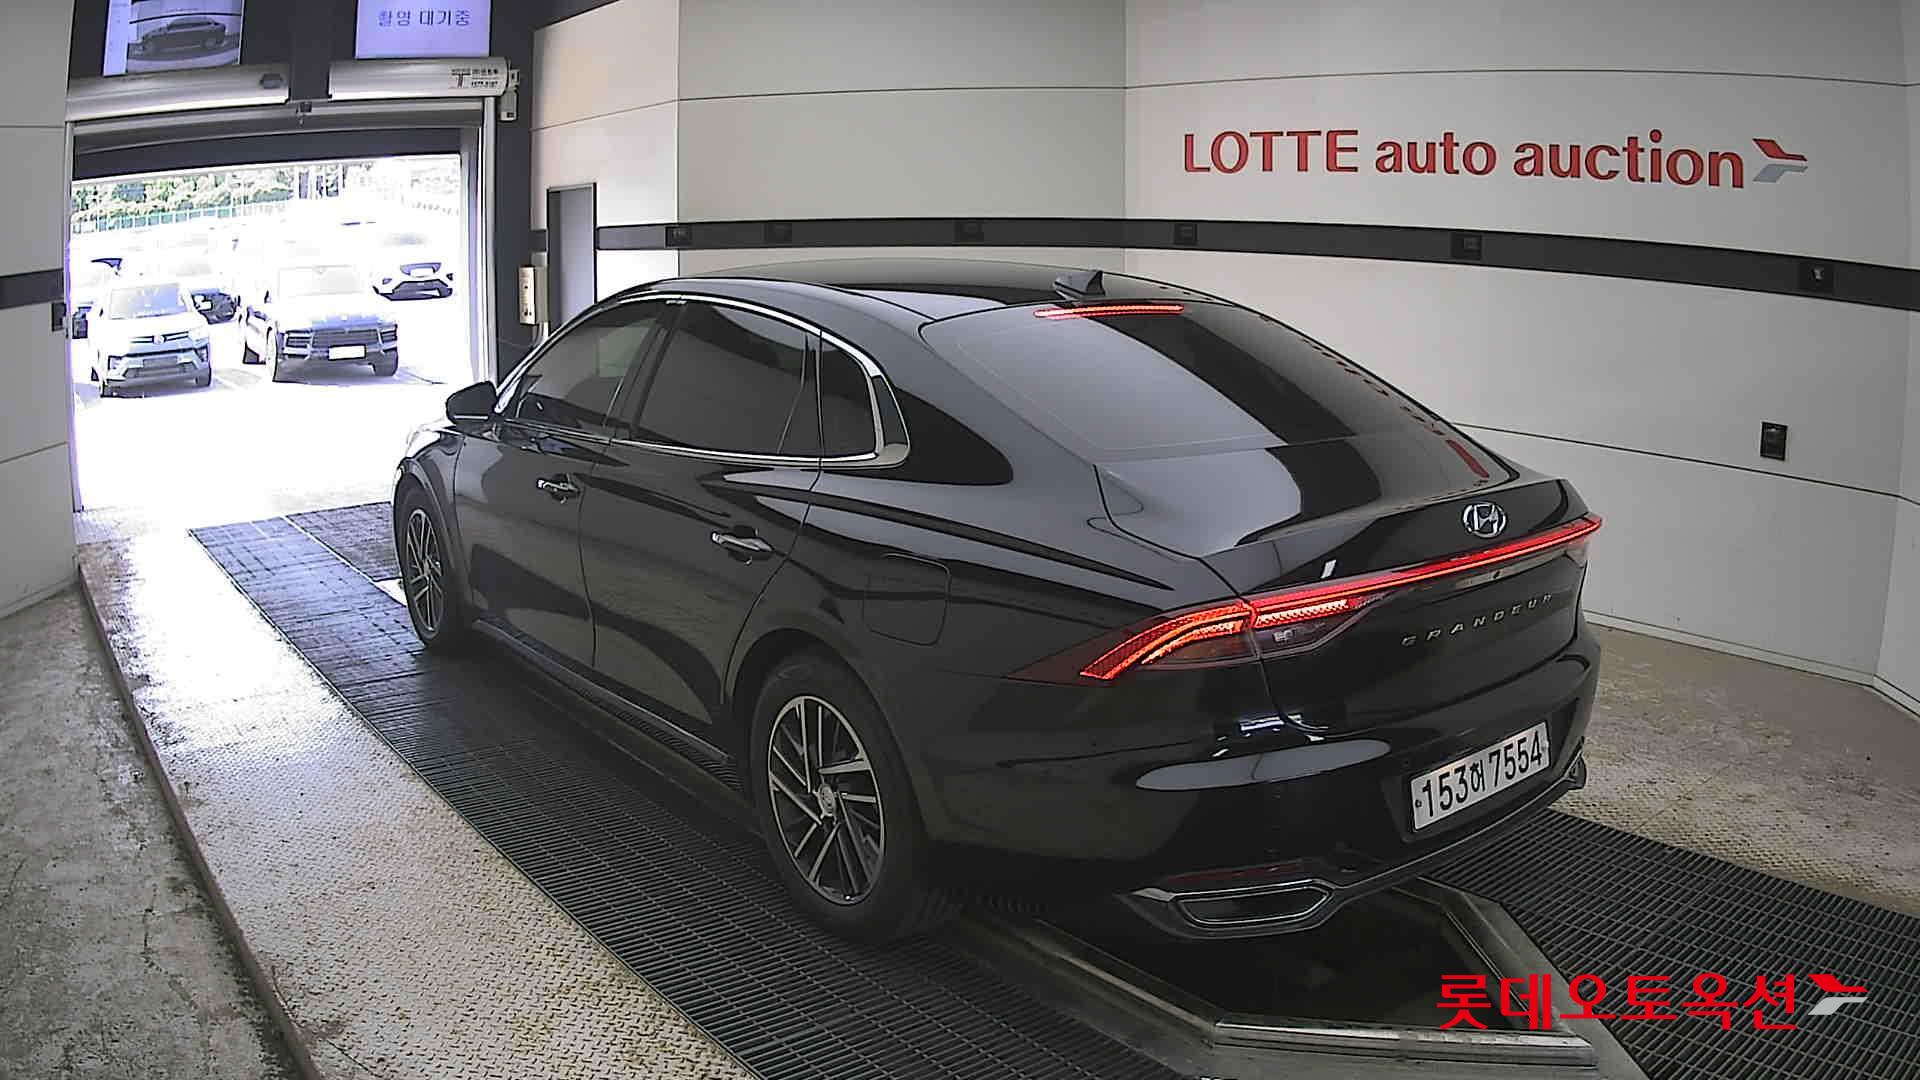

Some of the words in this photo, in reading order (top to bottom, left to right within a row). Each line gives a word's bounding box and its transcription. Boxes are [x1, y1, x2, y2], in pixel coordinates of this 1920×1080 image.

[1184, 129, 1359, 174] LOTTE
[1375, 131, 1497, 177] auto
[1513, 129, 1745, 189] auction
[1401, 594, 1553, 647] GRANDEUR
[1488, 730, 1543, 788] 7554
